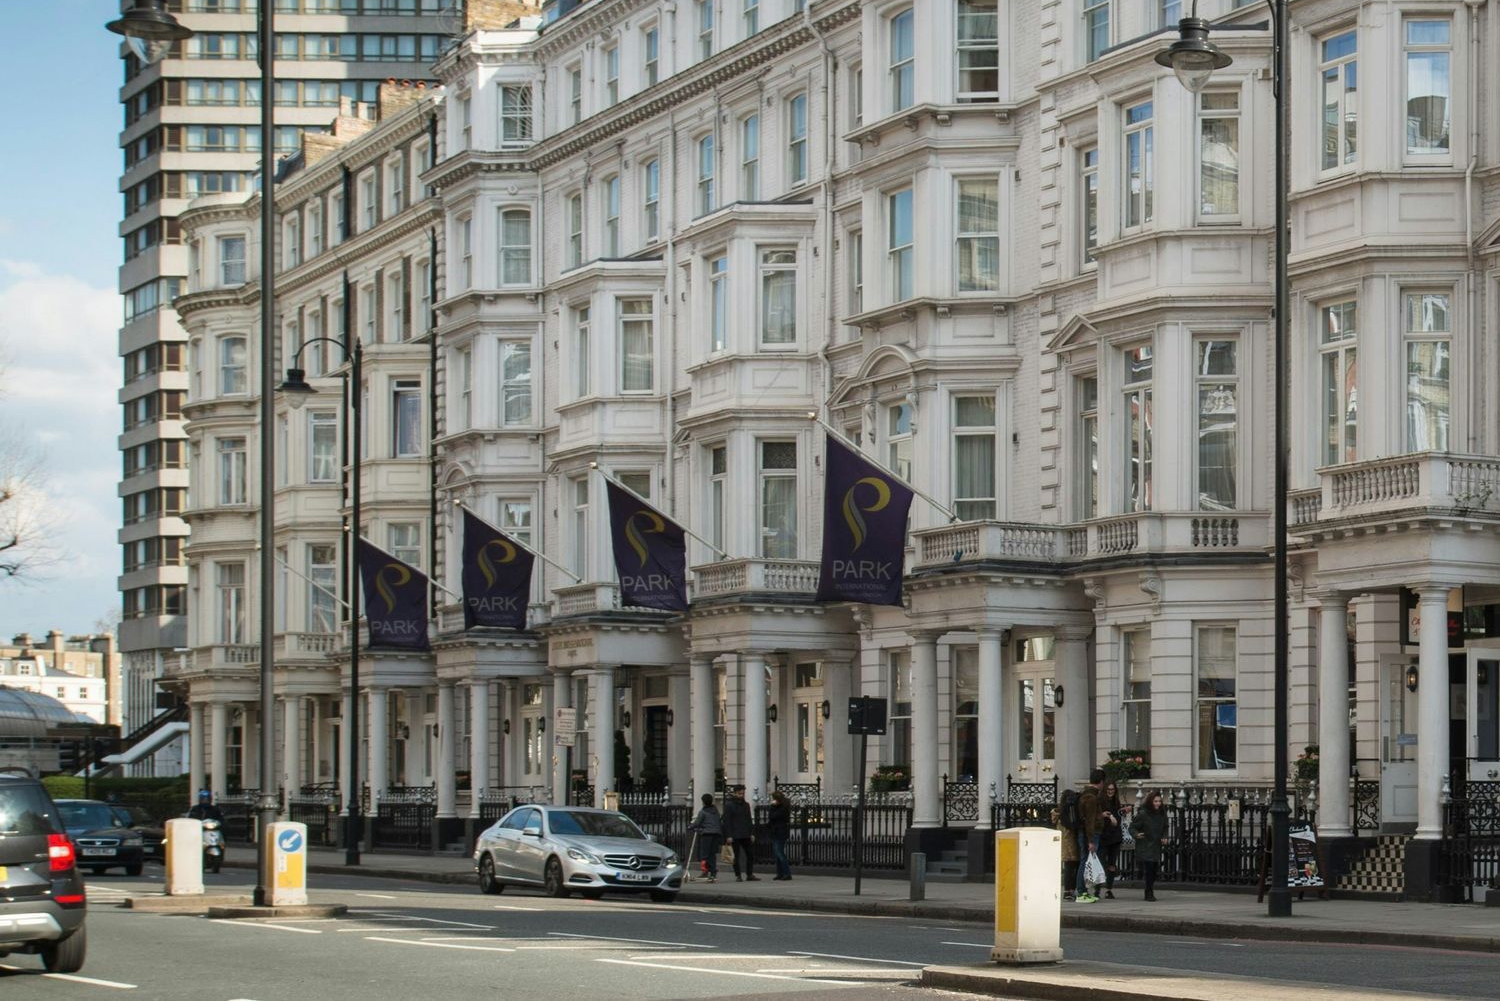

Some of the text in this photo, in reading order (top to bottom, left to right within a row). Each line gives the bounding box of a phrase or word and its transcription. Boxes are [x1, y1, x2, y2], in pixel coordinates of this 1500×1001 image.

[832, 559, 892, 580] PARK
[622, 574, 675, 592] PARK
[468, 596, 518, 612] PARK
[370, 619, 418, 635] PARK
